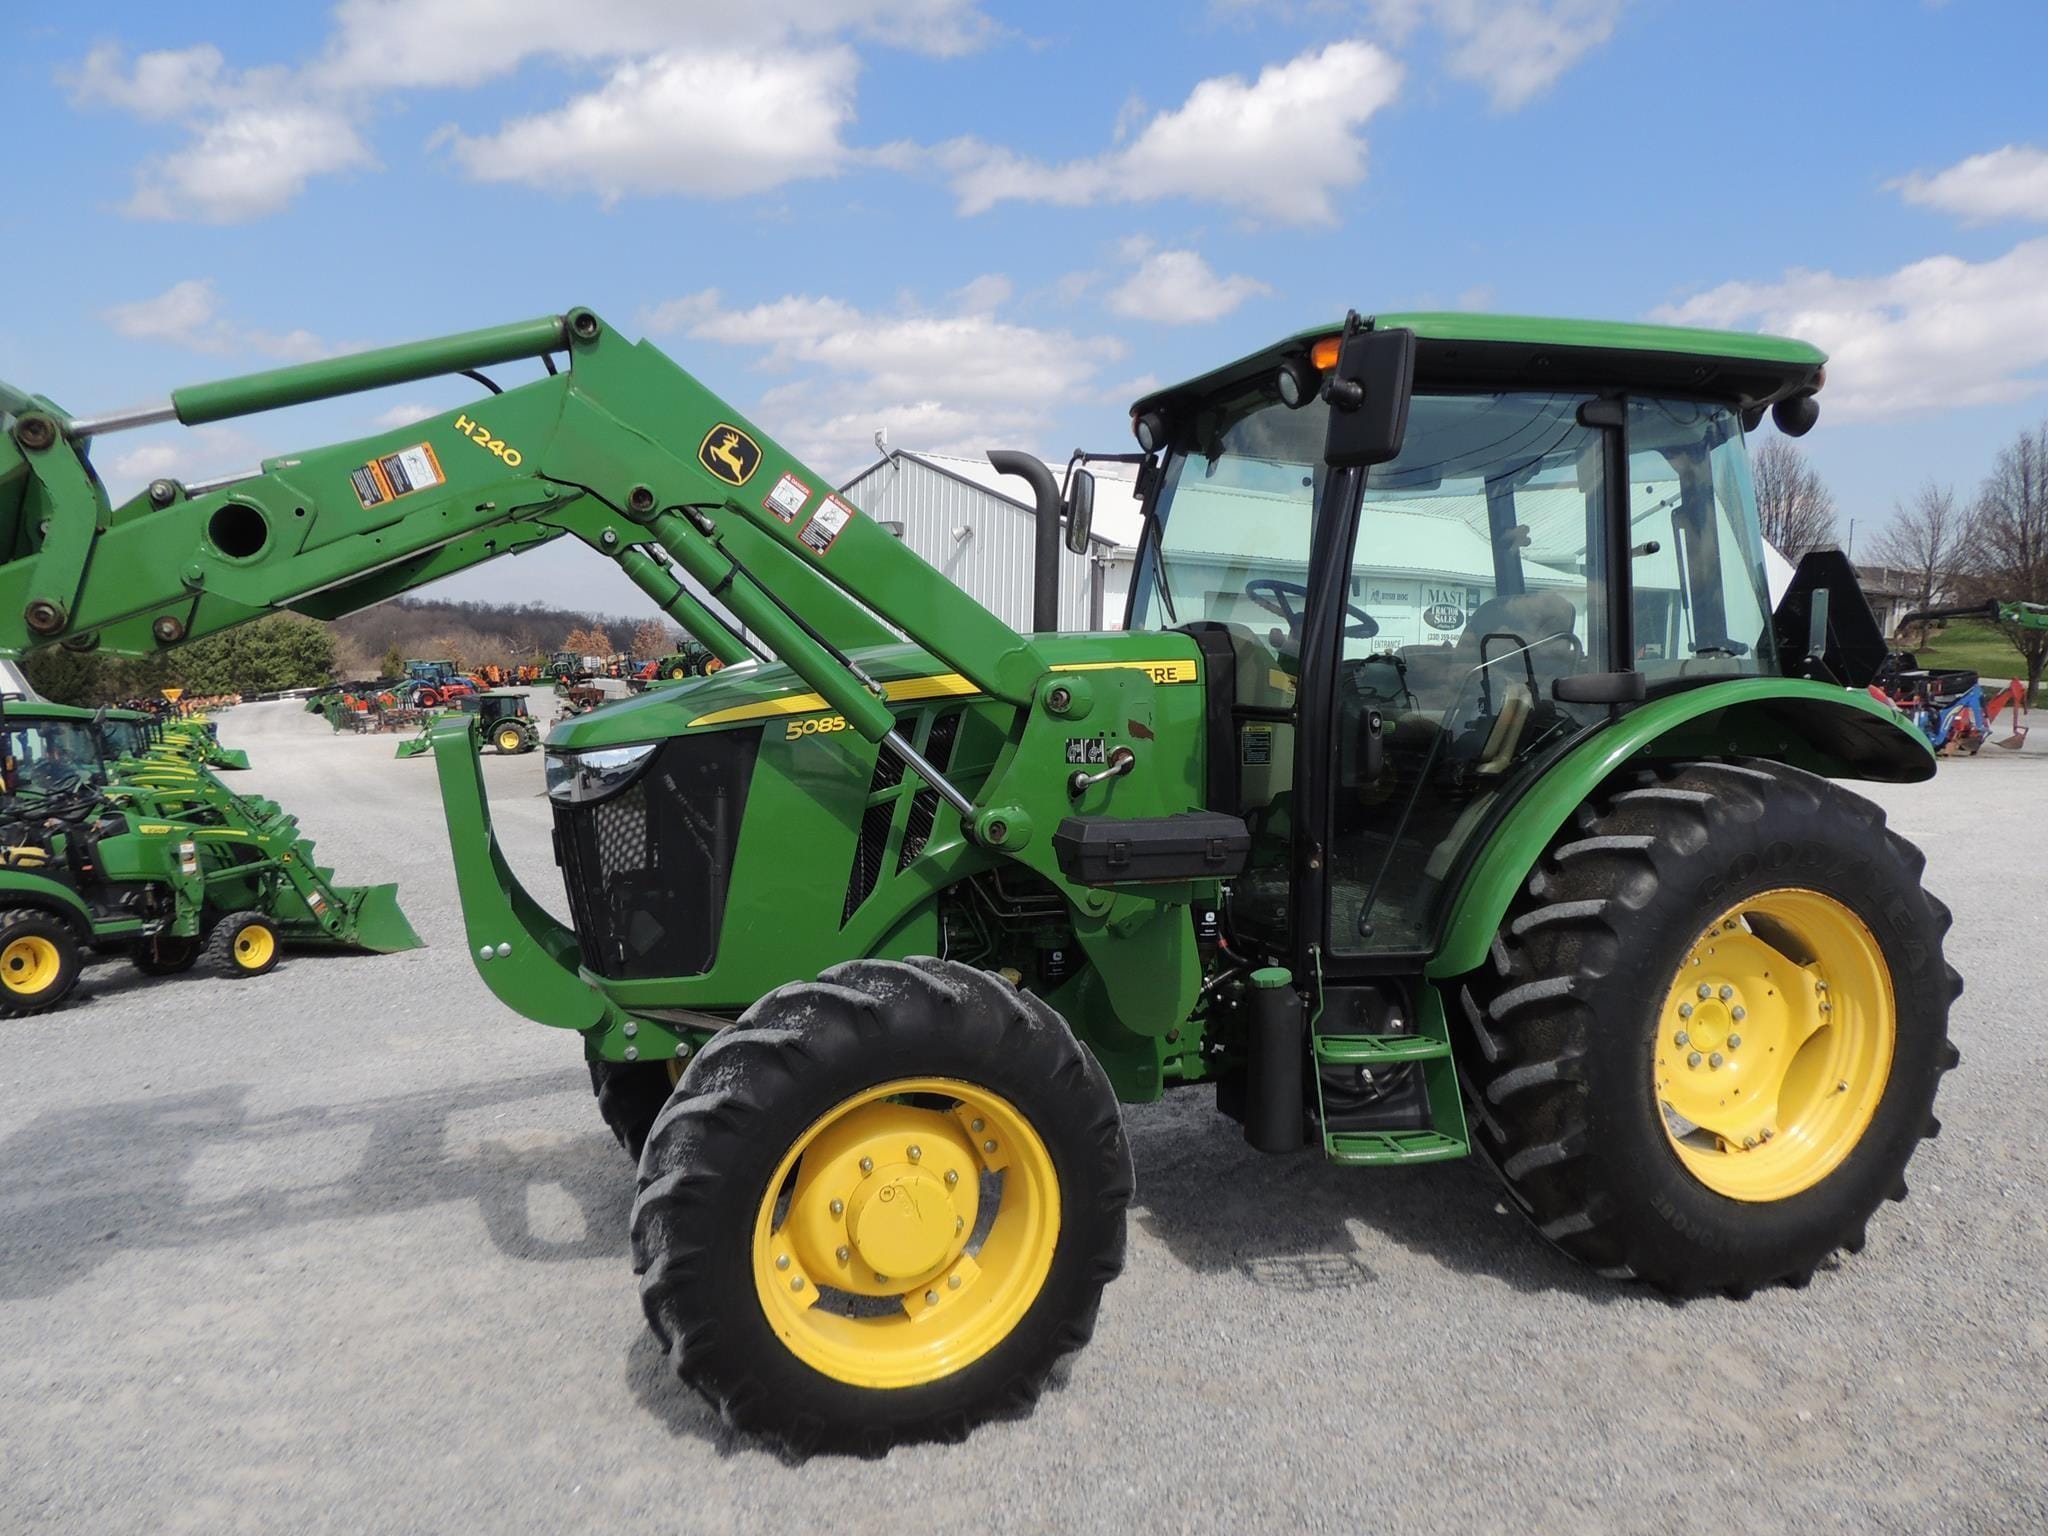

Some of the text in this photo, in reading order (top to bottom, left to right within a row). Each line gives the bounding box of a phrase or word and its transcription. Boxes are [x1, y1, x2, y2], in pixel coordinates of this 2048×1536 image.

[454, 414, 522, 467] H240
[1428, 589, 1464, 606] MAST
[1431, 604, 1459, 616] TRACTOR
[1434, 614, 1457, 624] SALES
[1374, 639, 1401, 649] ENTRANCE
[785, 696, 855, 741] 5085
